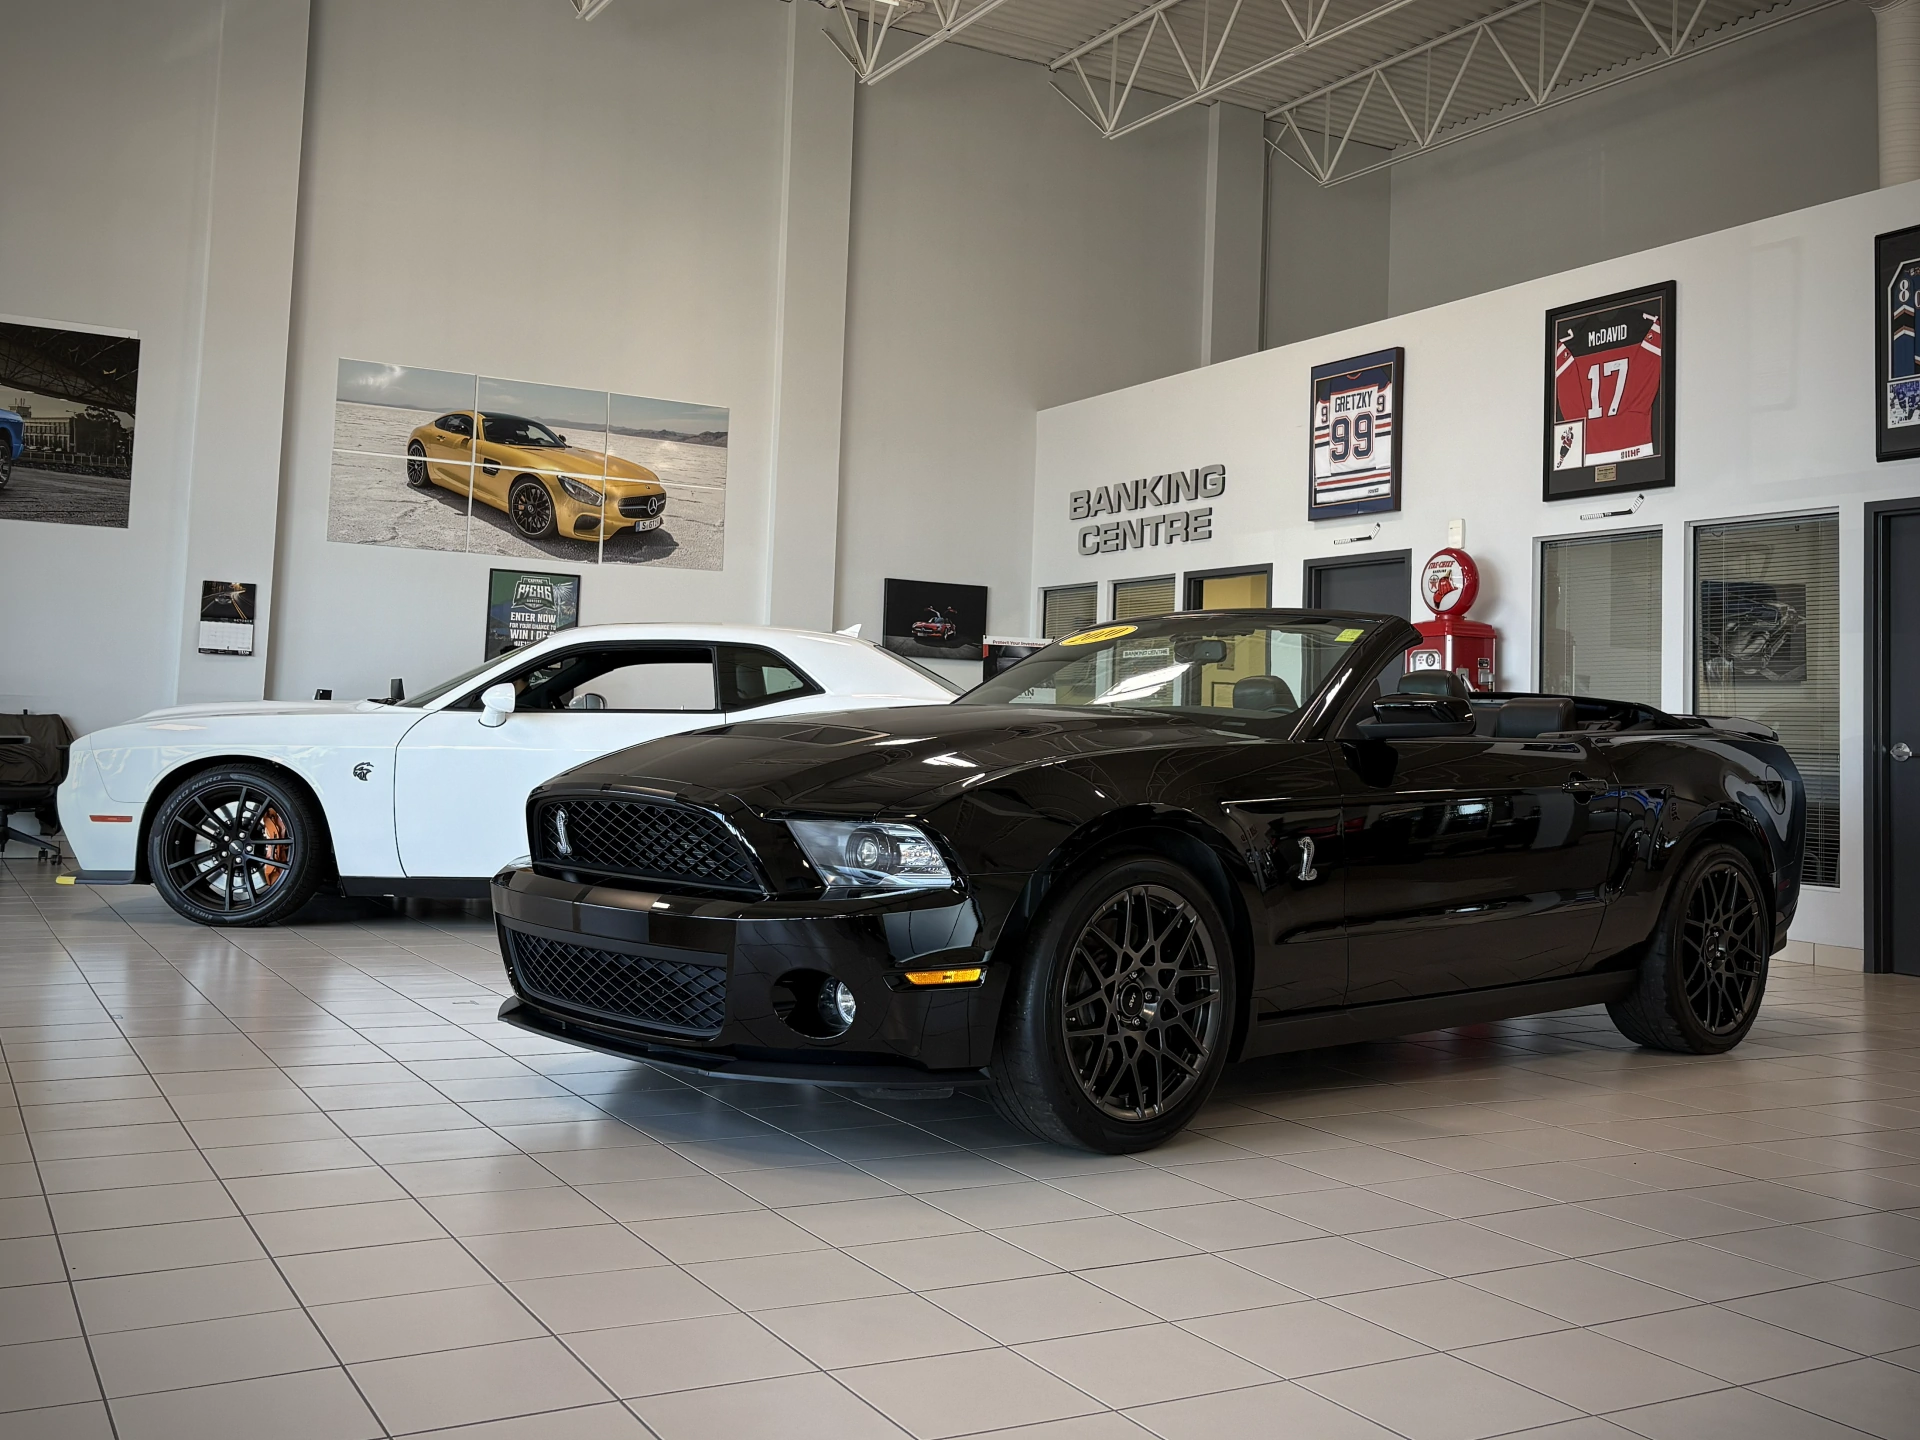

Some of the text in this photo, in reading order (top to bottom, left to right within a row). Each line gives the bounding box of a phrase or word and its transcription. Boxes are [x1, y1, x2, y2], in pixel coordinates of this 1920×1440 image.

[1898, 279, 1910, 303] 8
[1588, 323, 1628, 347] McDAVID
[1335, 391, 1372, 413] GRETZKY
[1587, 357, 1629, 420] 17
[1330, 410, 1375, 464] 99
[1069, 463, 1226, 521] BANKING
[1078, 506, 1213, 556] CENTRE
[511, 612, 556, 623] ENTER NOW
[510, 629, 528, 640] WIN
[165, 789, 189, 817] ZERO
[191, 775, 222, 791] NERO
